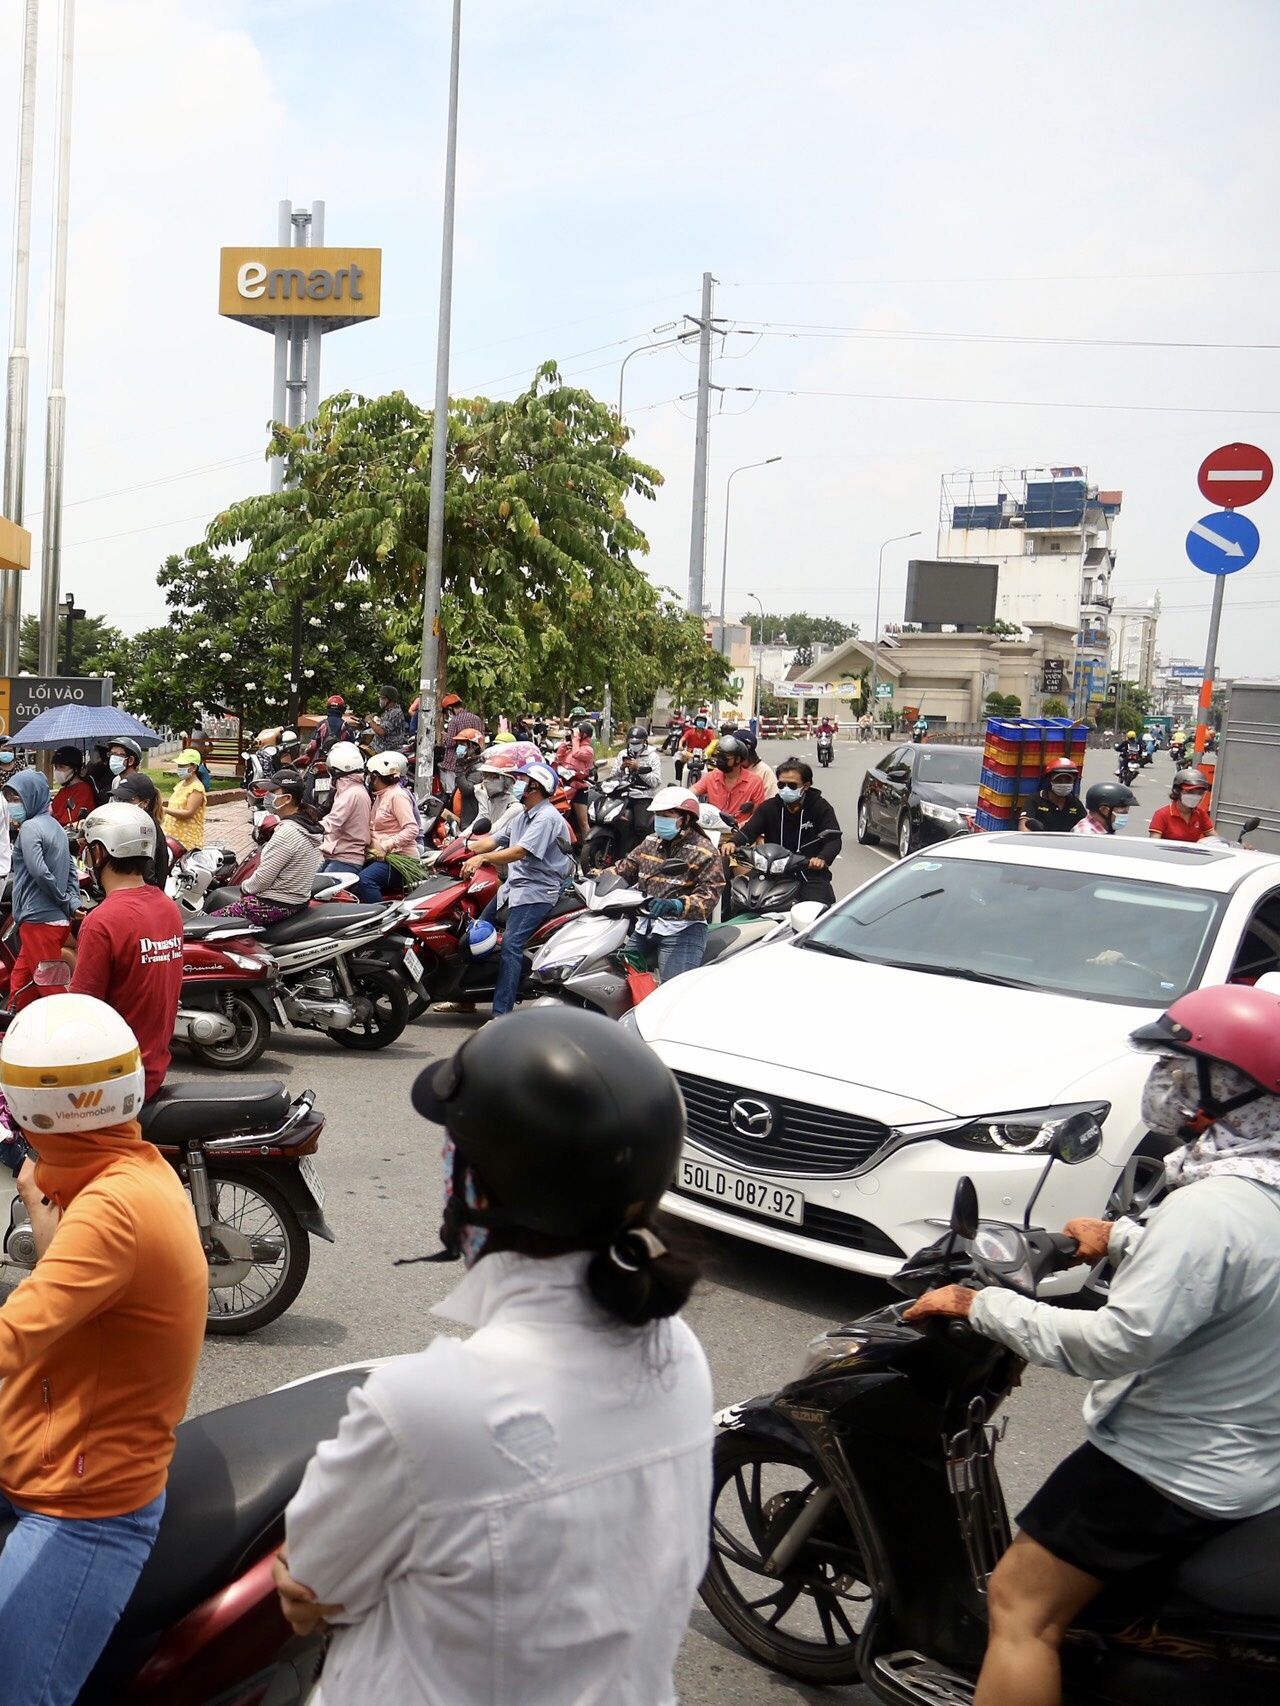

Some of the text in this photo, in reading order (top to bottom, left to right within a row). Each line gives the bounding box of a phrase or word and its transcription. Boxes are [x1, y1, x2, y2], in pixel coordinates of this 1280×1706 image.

[237, 262, 364, 300] emart
[28, 683, 84, 700] LỐI VÀO
[16, 703, 41, 716] ÔTÔ
[140, 934, 182, 955] Dynasty
[141, 951, 170, 964] Framing
[183, 963, 224, 972] Grande
[55, 1105, 116, 1120] Vietnamobile
[683, 1163, 795, 1218] 50LD-087.92
